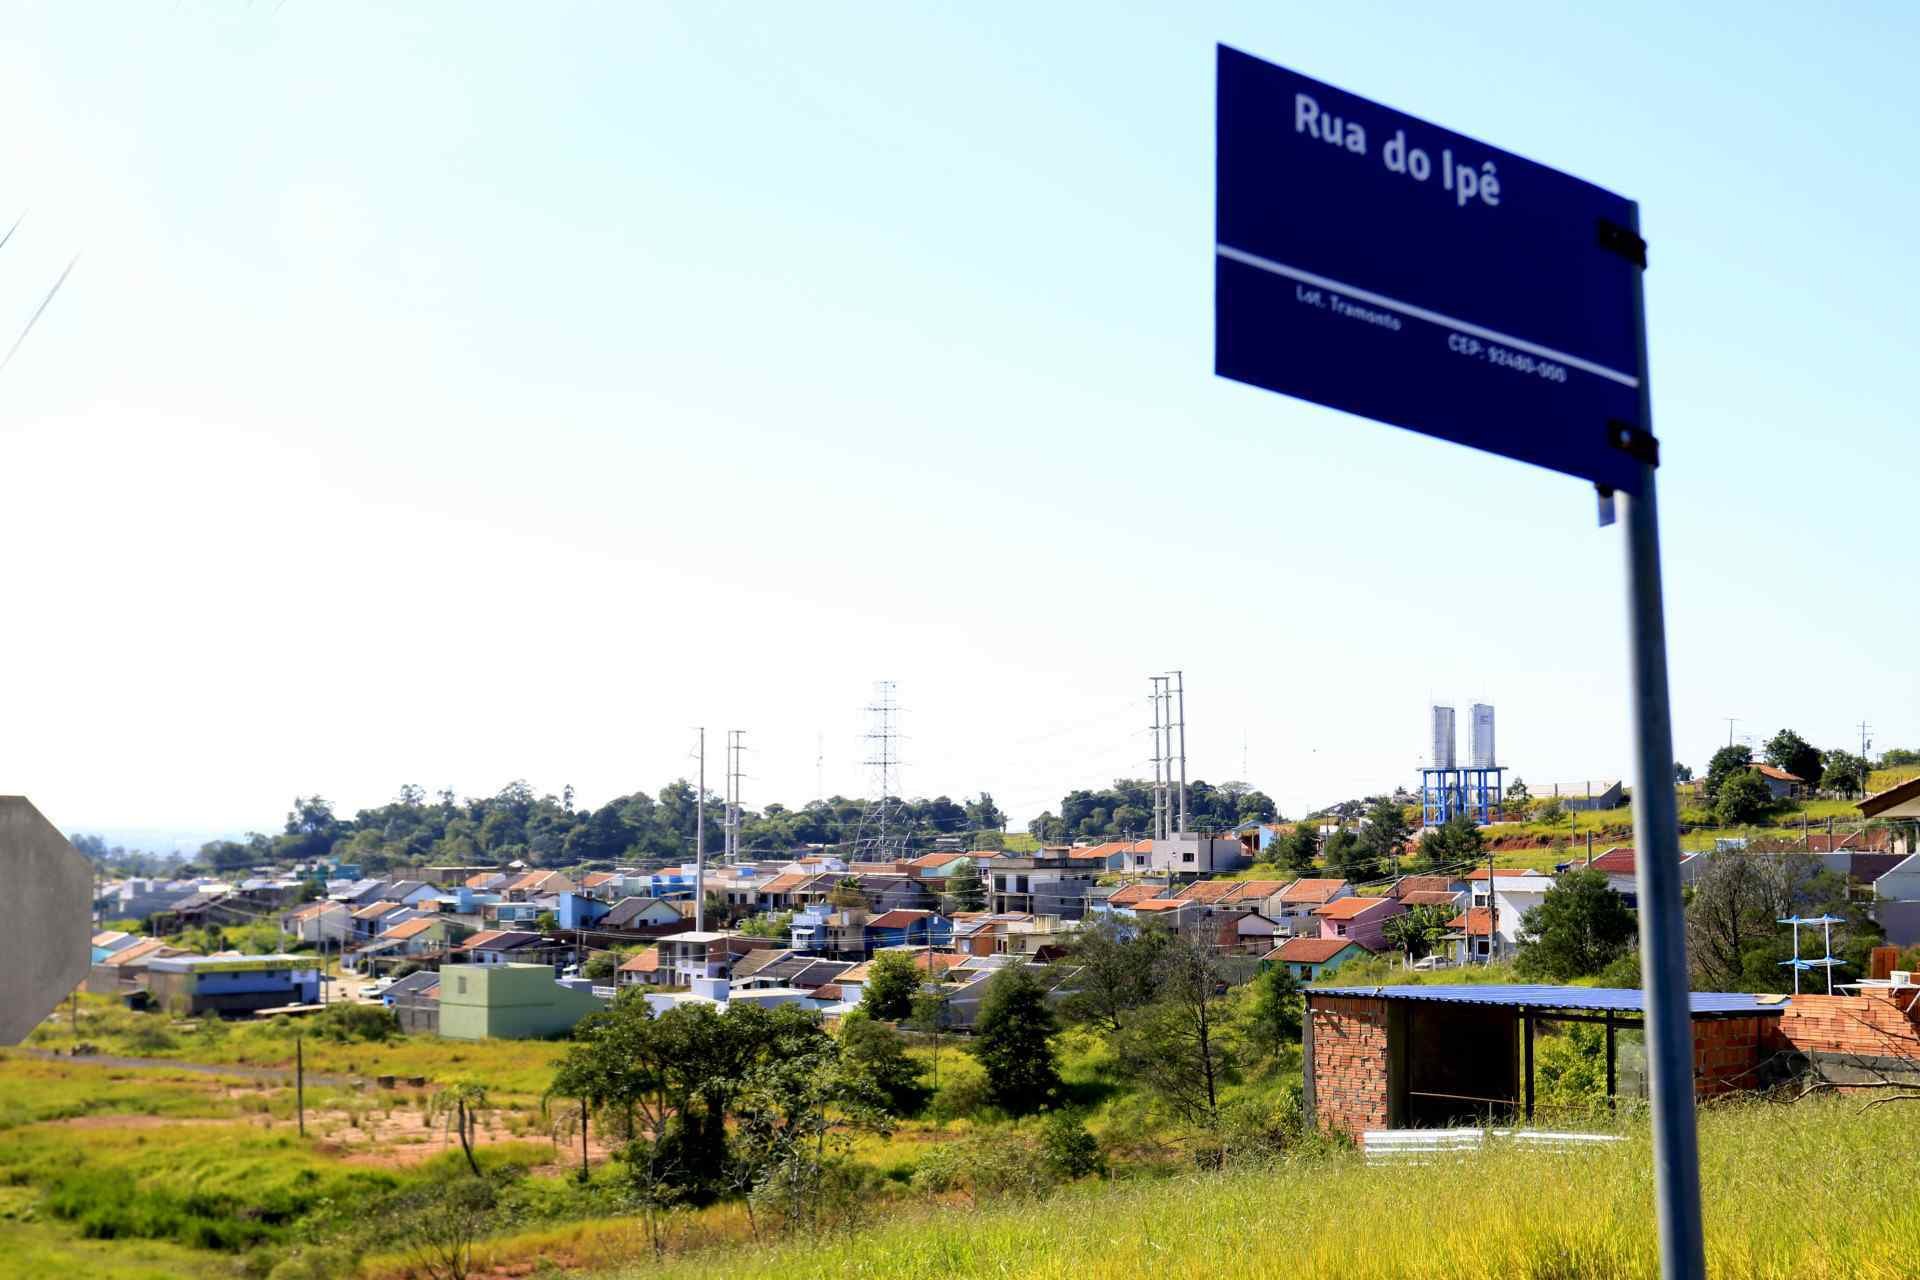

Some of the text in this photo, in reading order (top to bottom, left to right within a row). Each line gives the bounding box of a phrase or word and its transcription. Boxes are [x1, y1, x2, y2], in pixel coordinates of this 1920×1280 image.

[1295, 93, 1500, 206] Rua do Ipê
[1330, 294, 1401, 331] Tramonto
[1448, 333, 1567, 383] CEP: 92480-000
